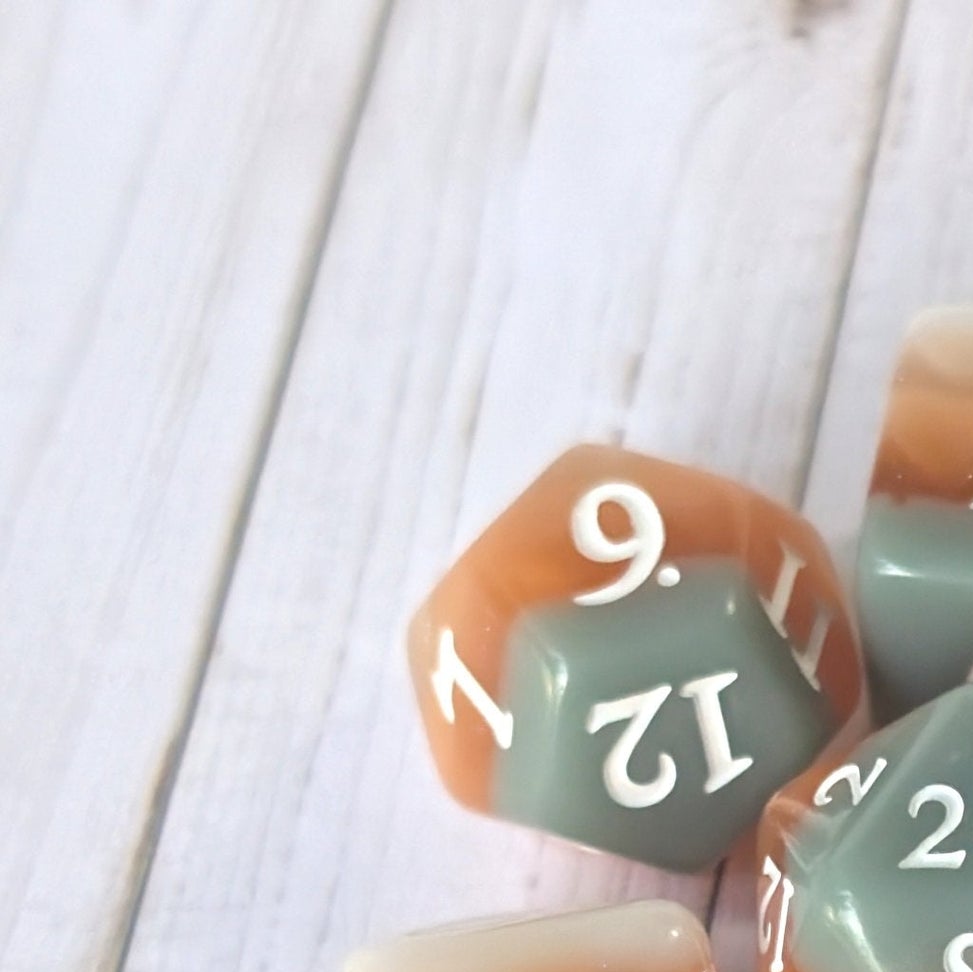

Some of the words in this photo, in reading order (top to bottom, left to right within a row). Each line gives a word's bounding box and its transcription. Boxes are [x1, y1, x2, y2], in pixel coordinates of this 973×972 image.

[756, 537, 836, 692] 11
[585, 670, 755, 810] 12
[813, 757, 888, 808] 2
